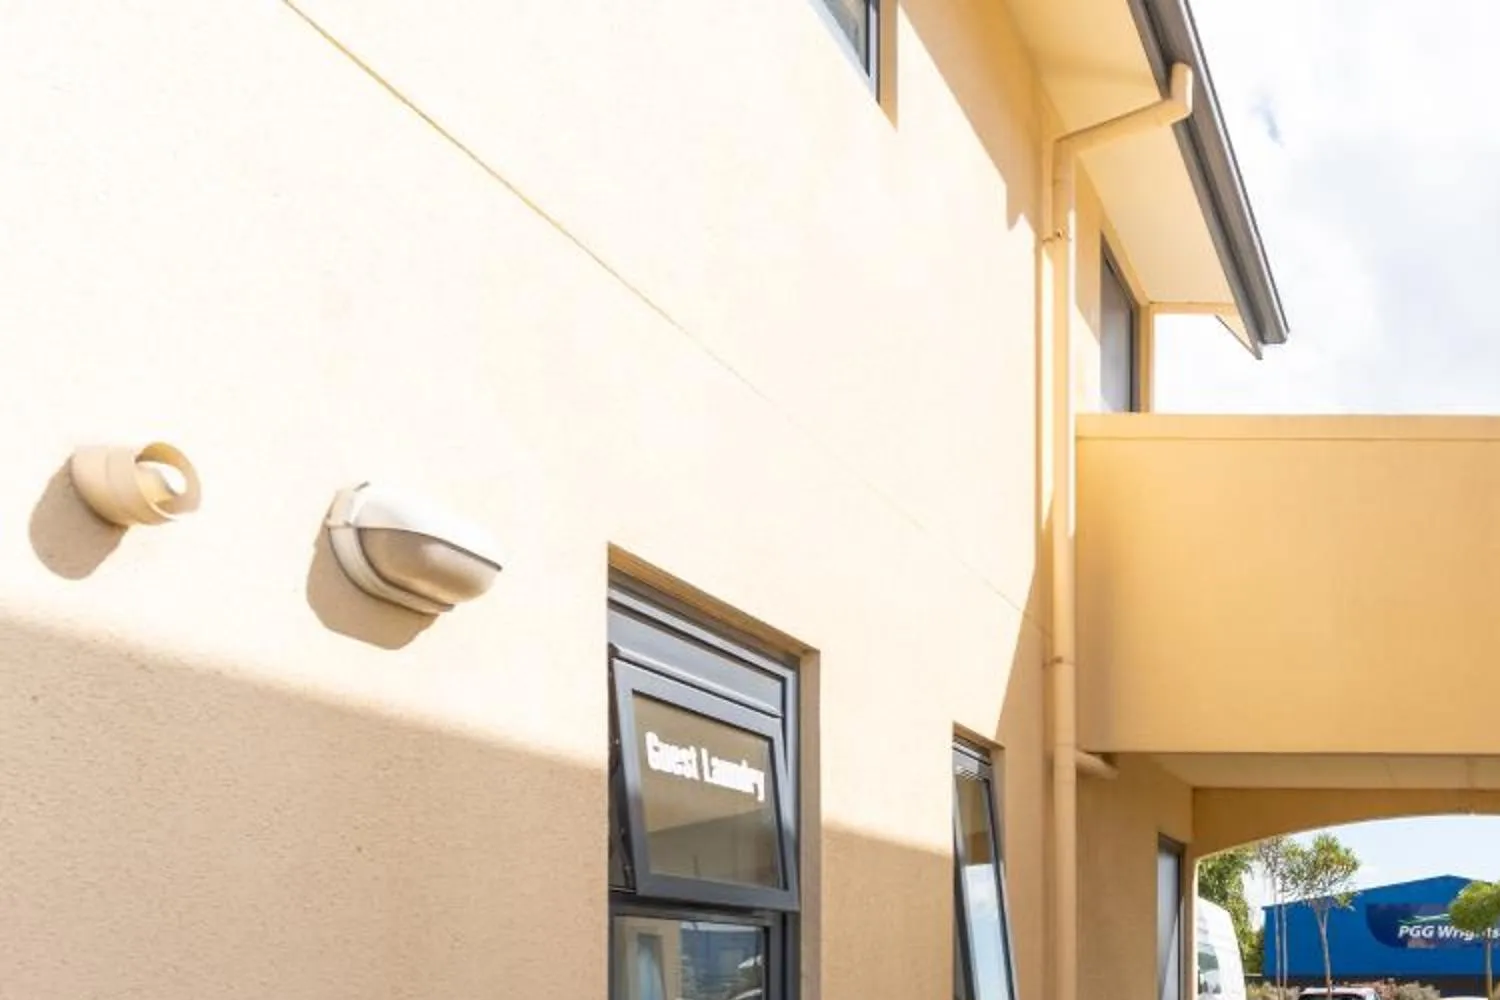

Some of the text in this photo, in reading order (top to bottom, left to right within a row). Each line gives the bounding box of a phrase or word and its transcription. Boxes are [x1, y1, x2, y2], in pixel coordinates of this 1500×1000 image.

[645, 731, 765, 801] Guest Laundry
[1397, 925, 1434, 939] PGG
